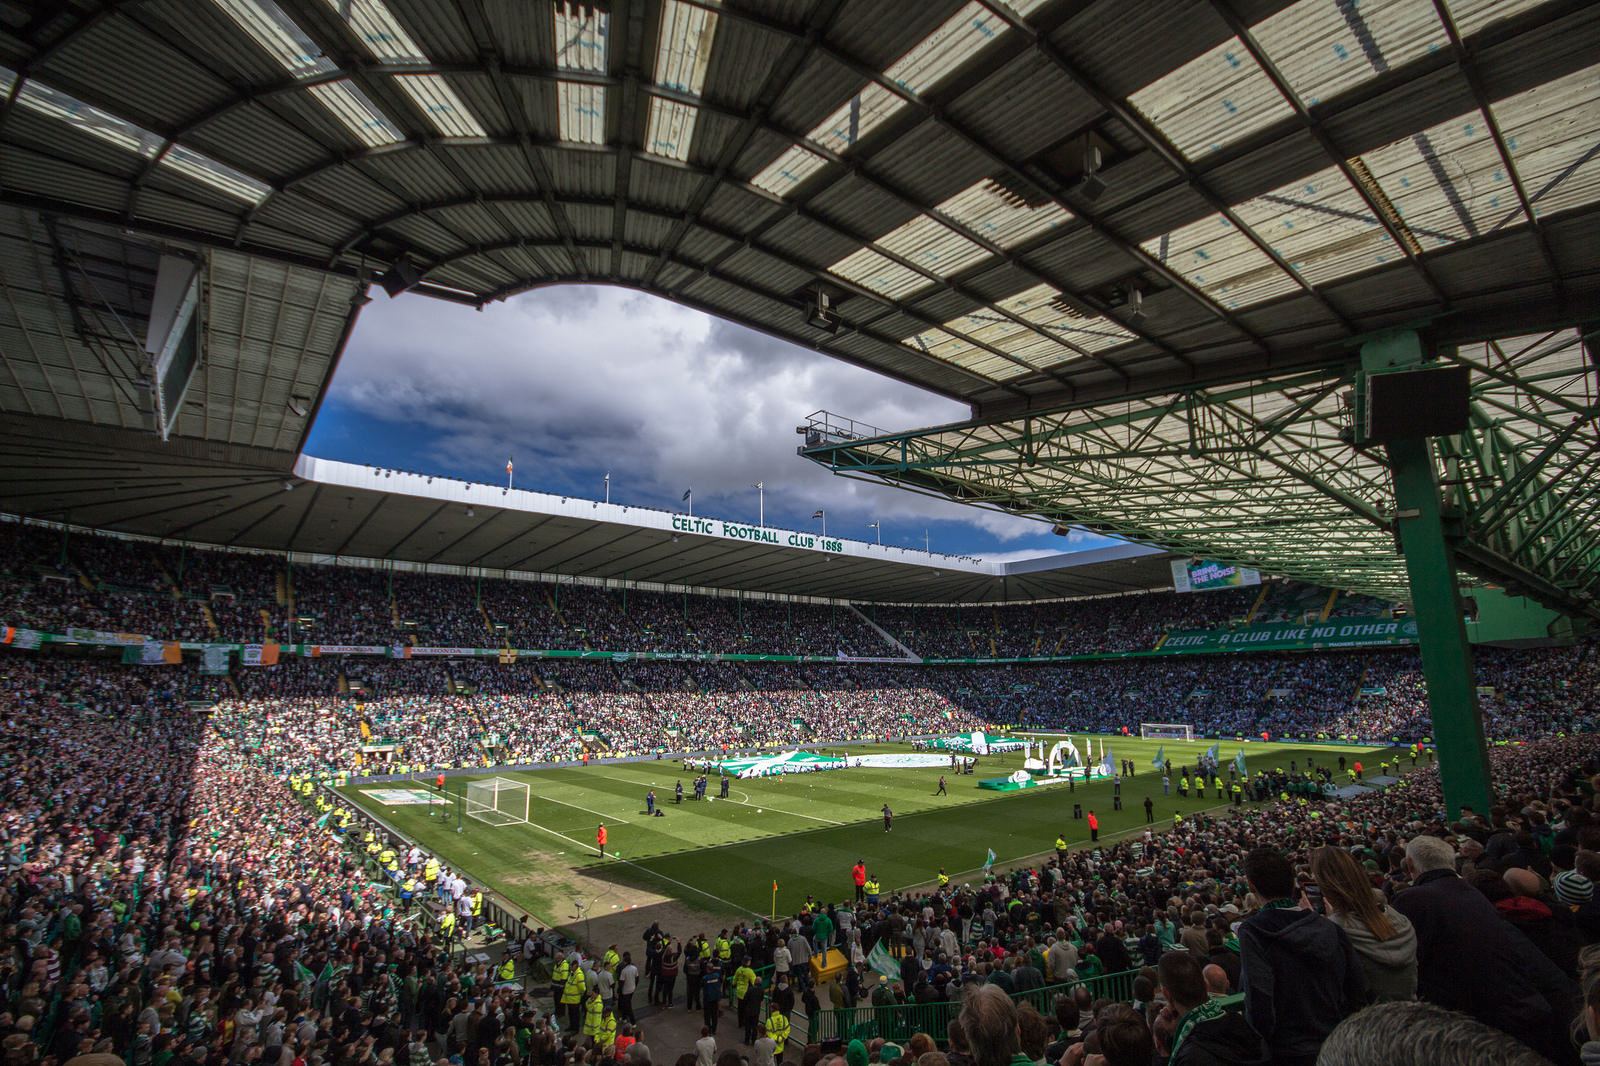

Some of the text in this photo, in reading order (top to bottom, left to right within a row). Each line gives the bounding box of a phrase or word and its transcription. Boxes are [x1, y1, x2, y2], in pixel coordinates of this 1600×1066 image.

[672, 517, 843, 552] CELTIC FOOTBALL CLUB 1888
[1191, 564, 1218, 578] BRING
[1194, 574, 1209, 584] THE
[1210, 566, 1236, 580] NOISE
[1164, 635, 1208, 647] CELTIC
[1218, 634, 1231, 644] A
[1232, 631, 1271, 643] CLUB
[1274, 628, 1309, 640] LIKE
[1311, 626, 1336, 638] NO
[1339, 623, 1398, 637] OTHER
